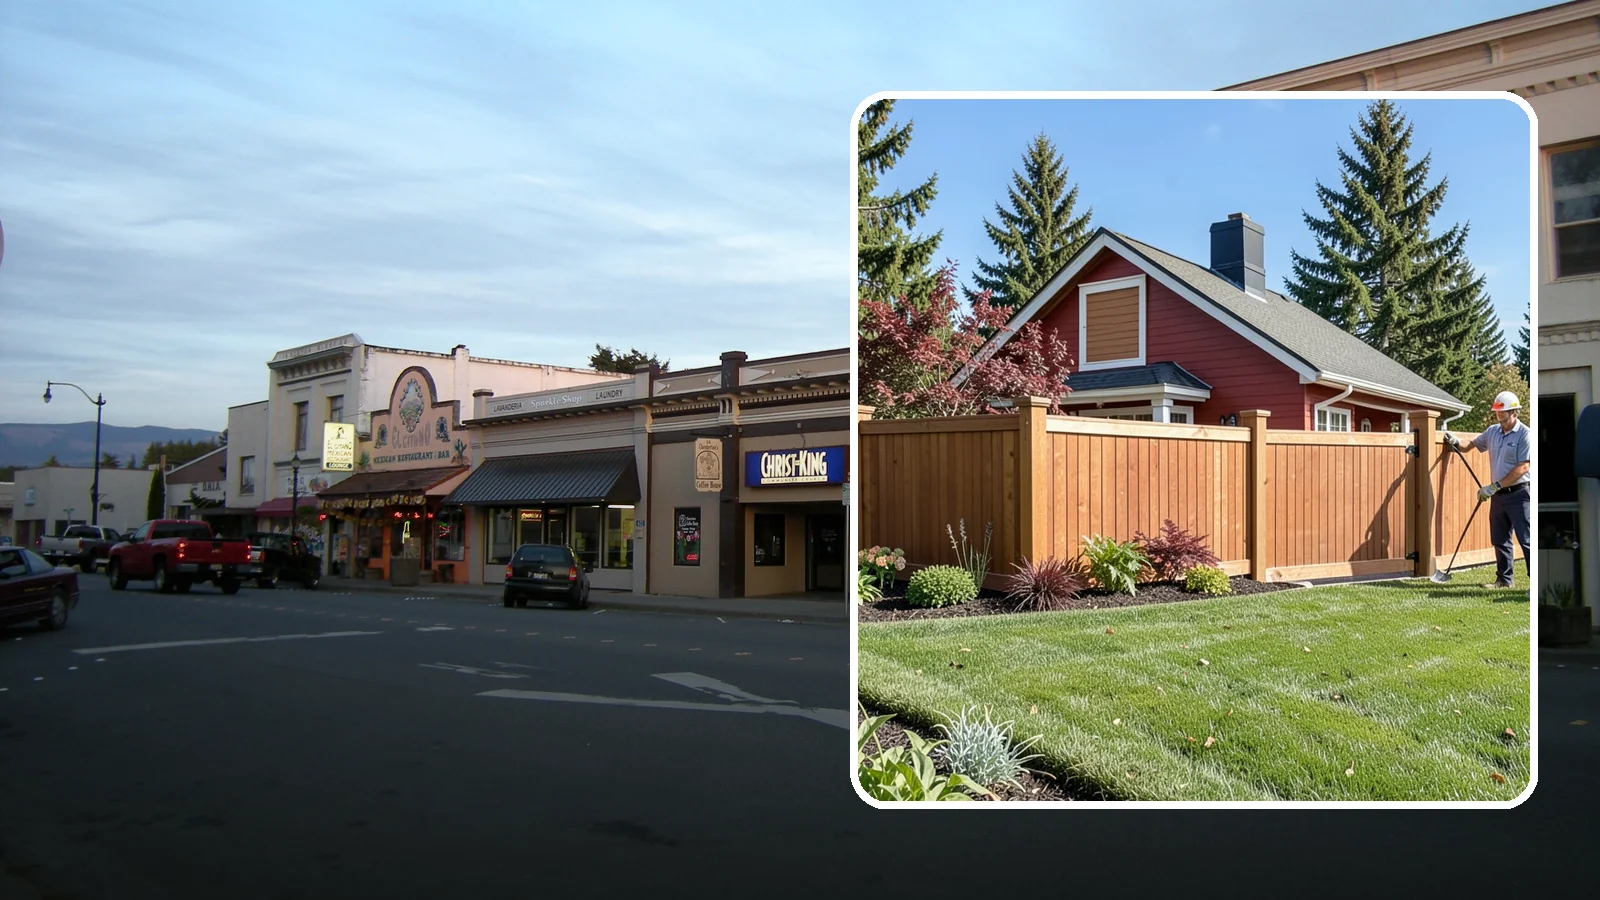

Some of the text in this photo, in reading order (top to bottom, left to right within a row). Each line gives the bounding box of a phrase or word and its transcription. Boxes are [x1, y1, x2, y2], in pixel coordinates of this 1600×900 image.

[493, 402, 523, 412] LAVANDERIA
[562, 395, 582, 405] Shop
[595, 389, 624, 399] LAUNDRY
[398, 451, 434, 462] RESTAURANT
[438, 450, 450, 459] BAR
[761, 450, 827, 478] CHRIST KING
